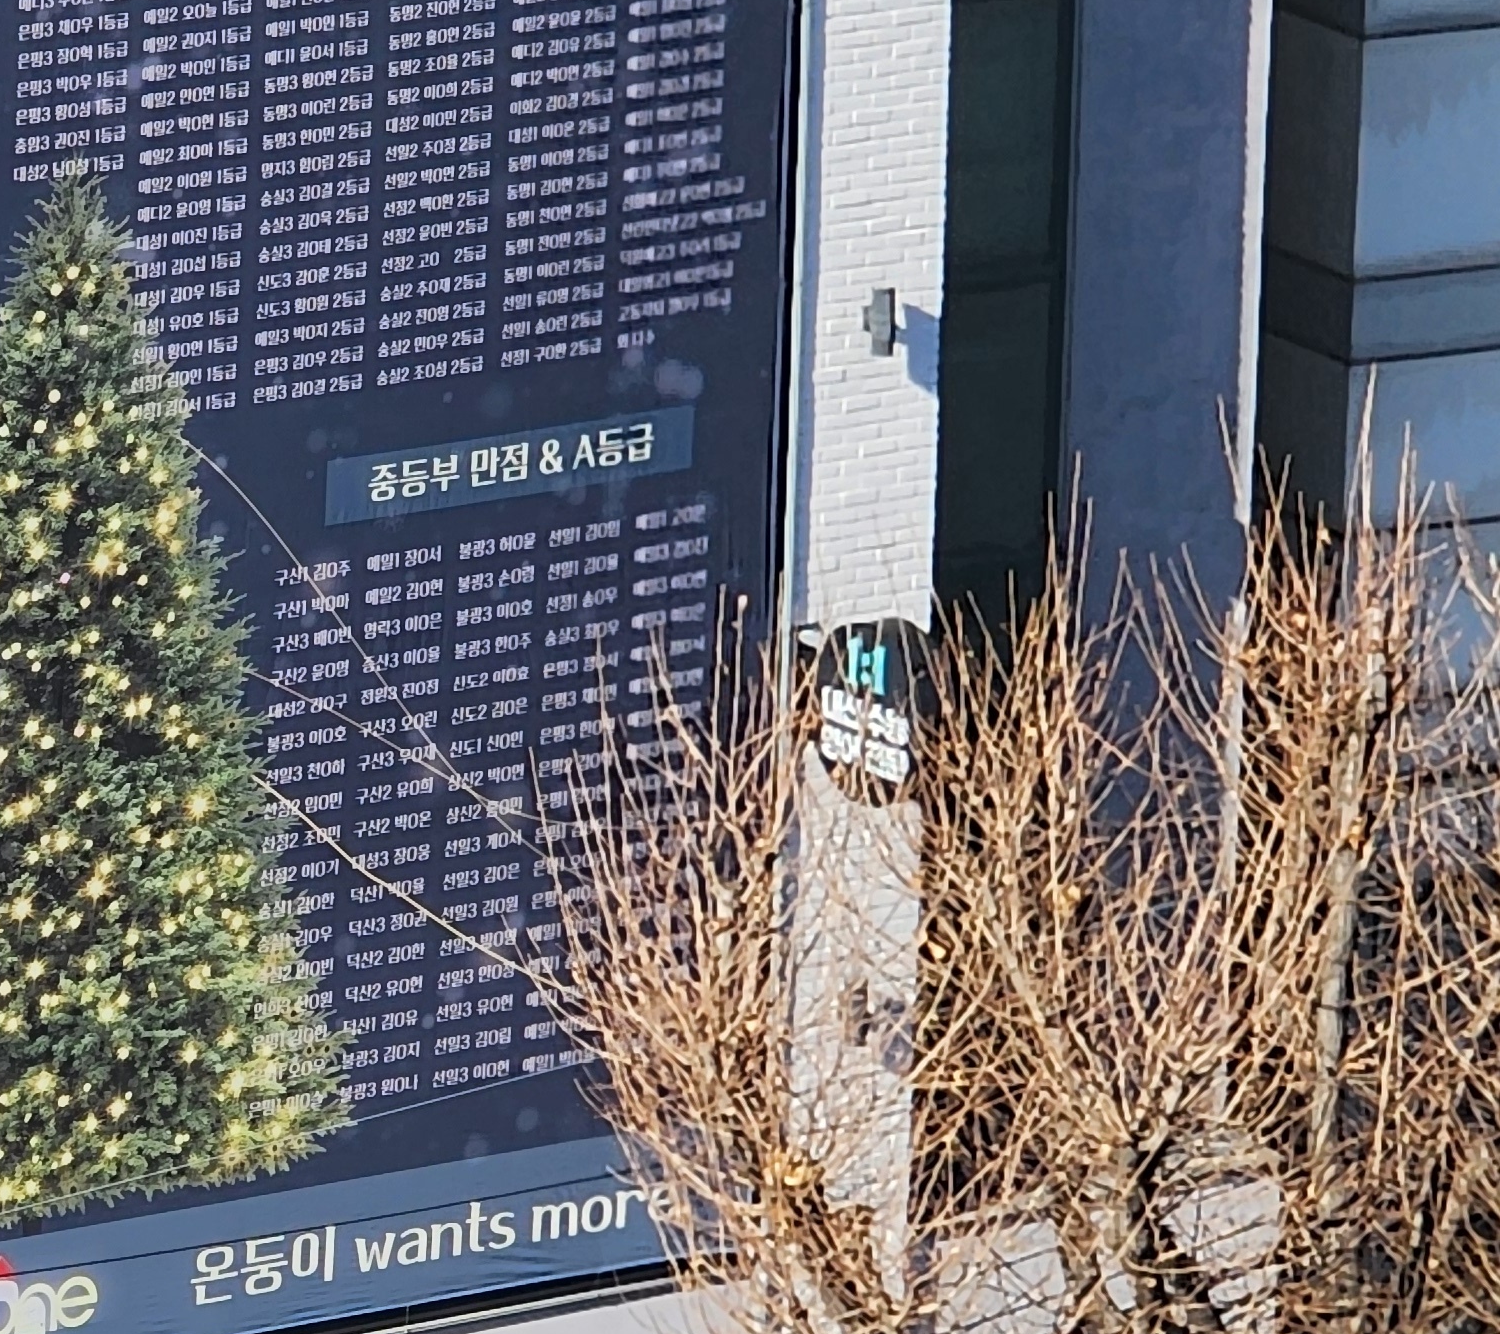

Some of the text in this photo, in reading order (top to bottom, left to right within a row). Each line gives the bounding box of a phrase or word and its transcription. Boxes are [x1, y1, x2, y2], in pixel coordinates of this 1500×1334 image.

[367, 423, 656, 503] 중등부 만점 & A등급
[190, 1224, 336, 1306] 온둥이
[355, 1201, 517, 1274] wants
